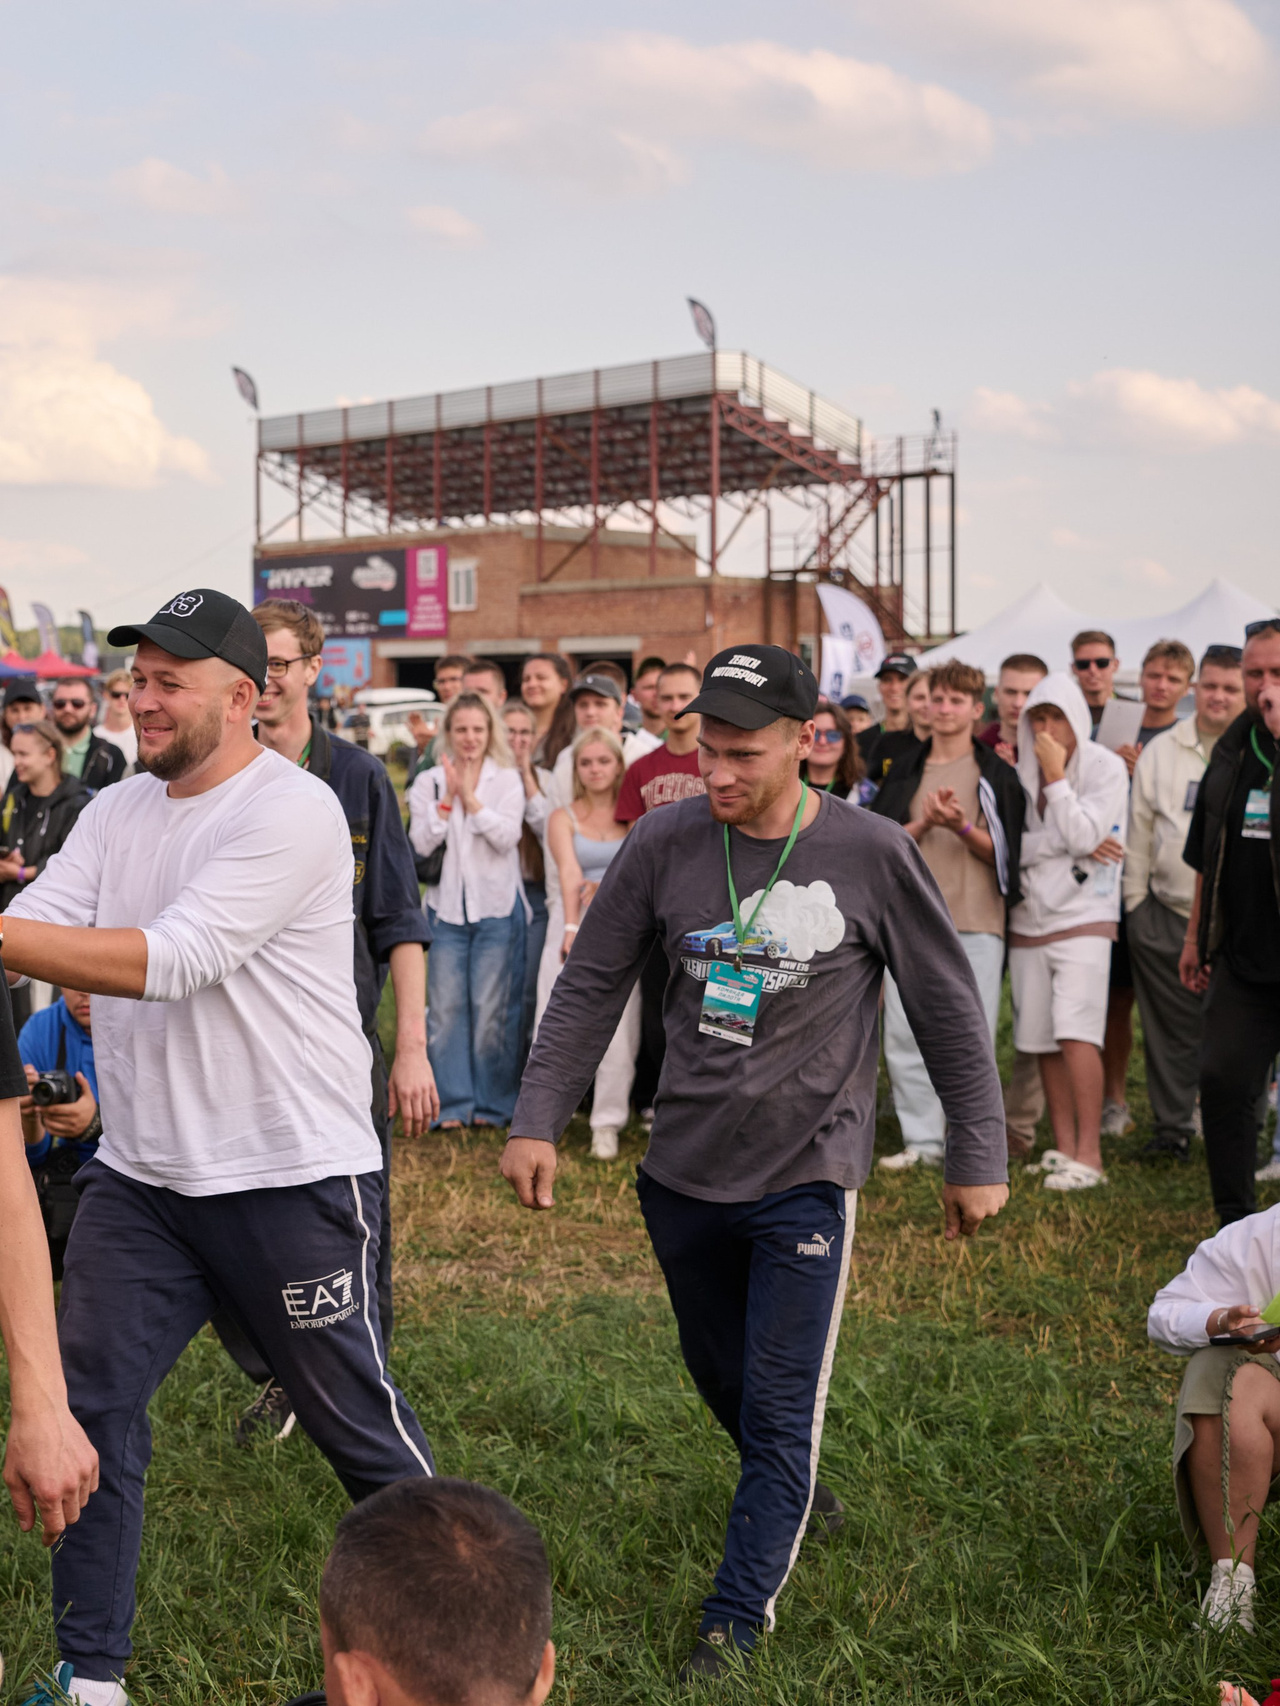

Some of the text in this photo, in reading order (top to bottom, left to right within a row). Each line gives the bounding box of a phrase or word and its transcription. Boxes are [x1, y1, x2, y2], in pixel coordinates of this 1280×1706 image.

[728, 654, 761, 669] ZENICH
[711, 667, 768, 687] MOTORSPORT
[779, 960, 797, 970] BMW
[797, 1243, 826, 1256] PUMA
[282, 1271, 353, 1316] EA7
[290, 1320, 328, 1330] EMPORIO
